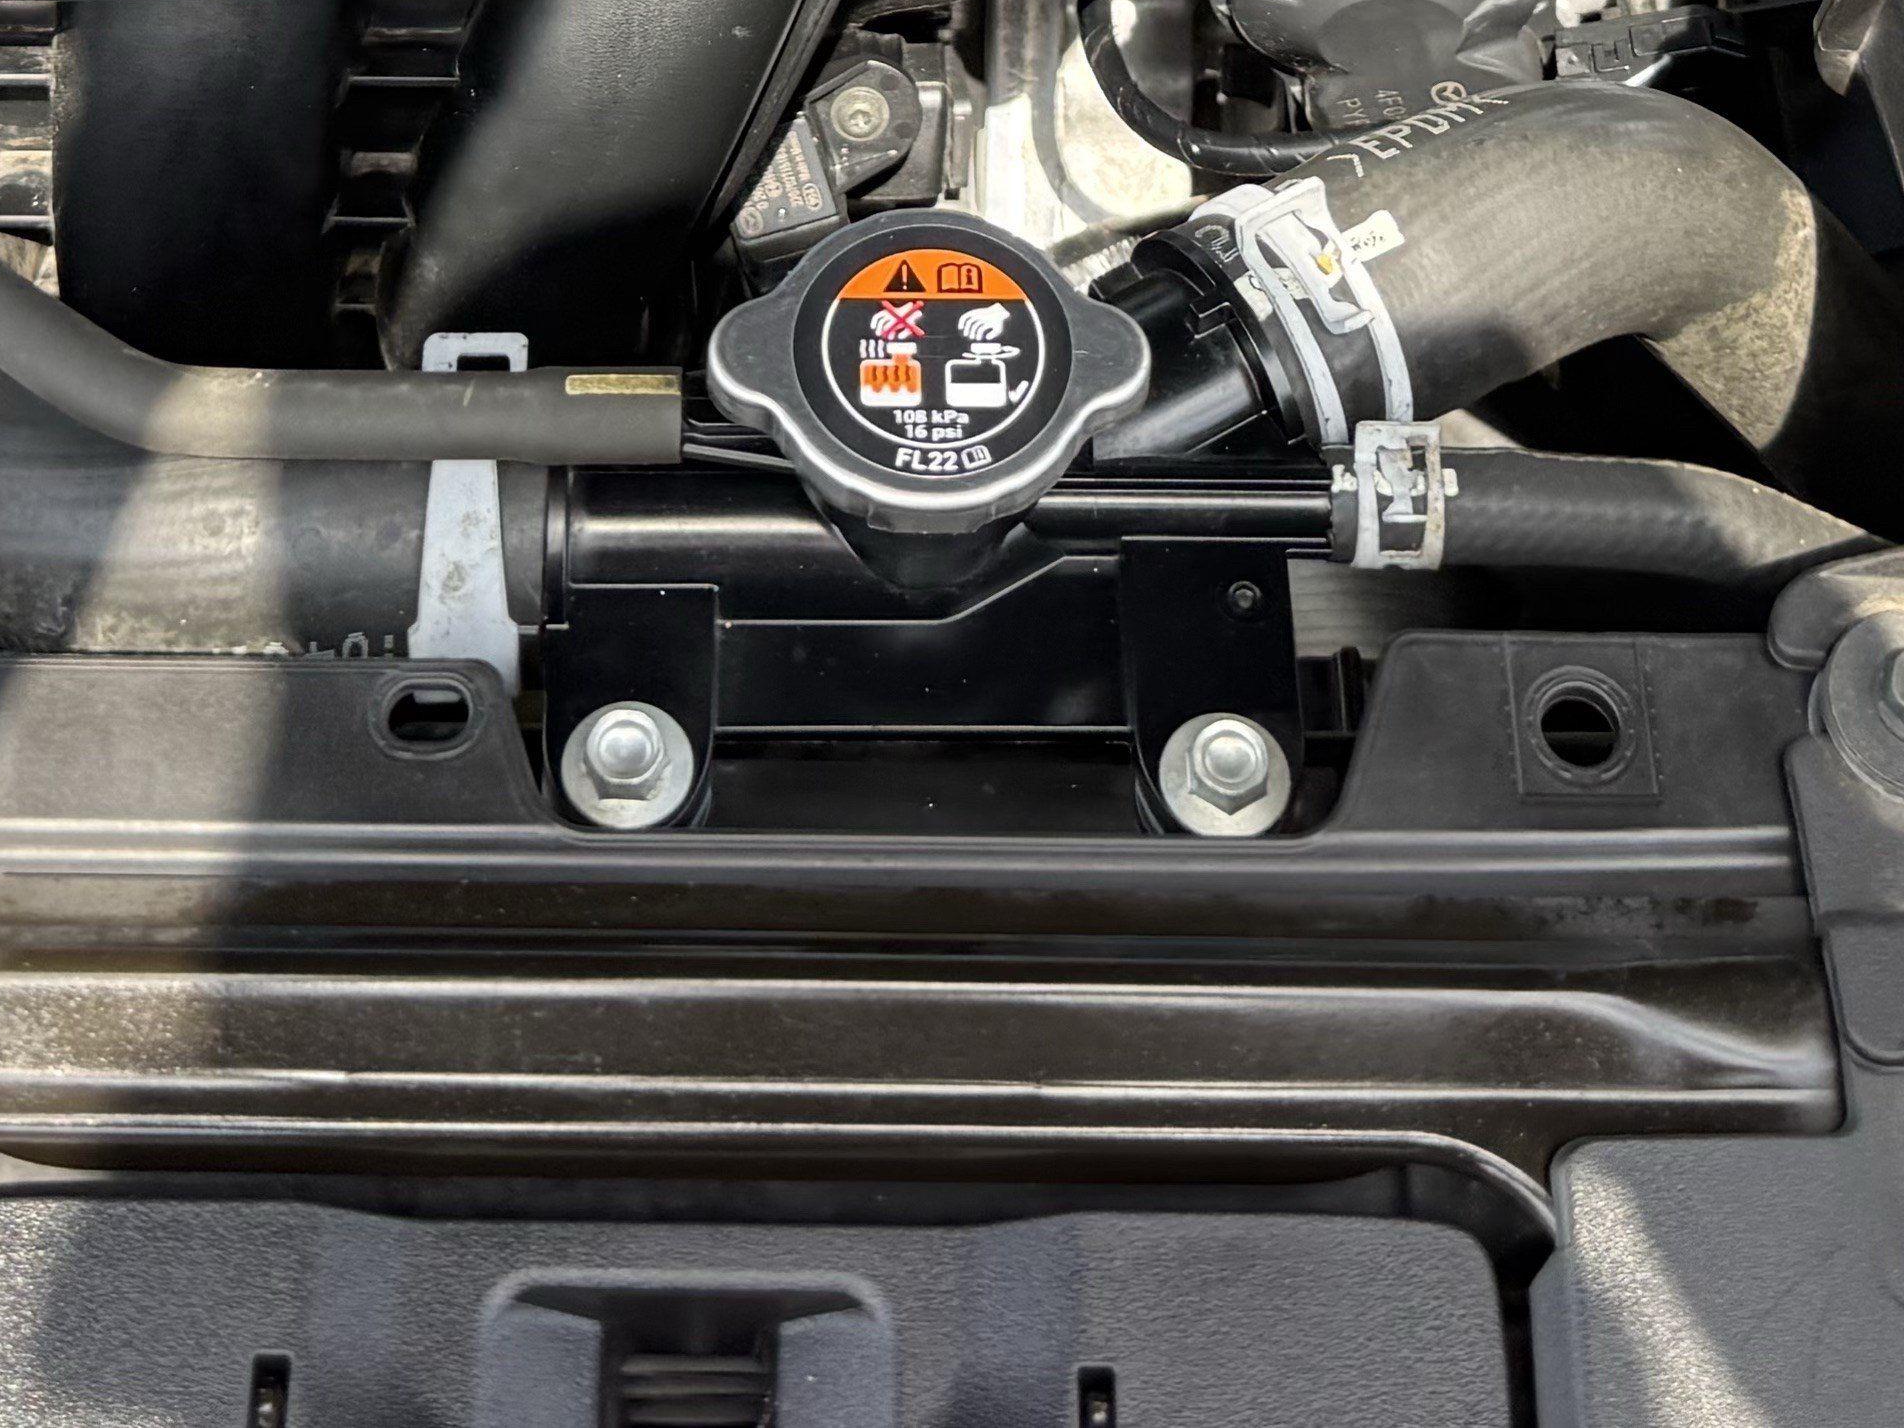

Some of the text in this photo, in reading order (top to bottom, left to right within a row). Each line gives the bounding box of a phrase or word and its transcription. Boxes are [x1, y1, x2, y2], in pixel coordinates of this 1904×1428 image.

[893, 409, 970, 425] 108 kPa
[904, 424, 964, 442] 16 psi
[894, 446, 959, 472] FL22
